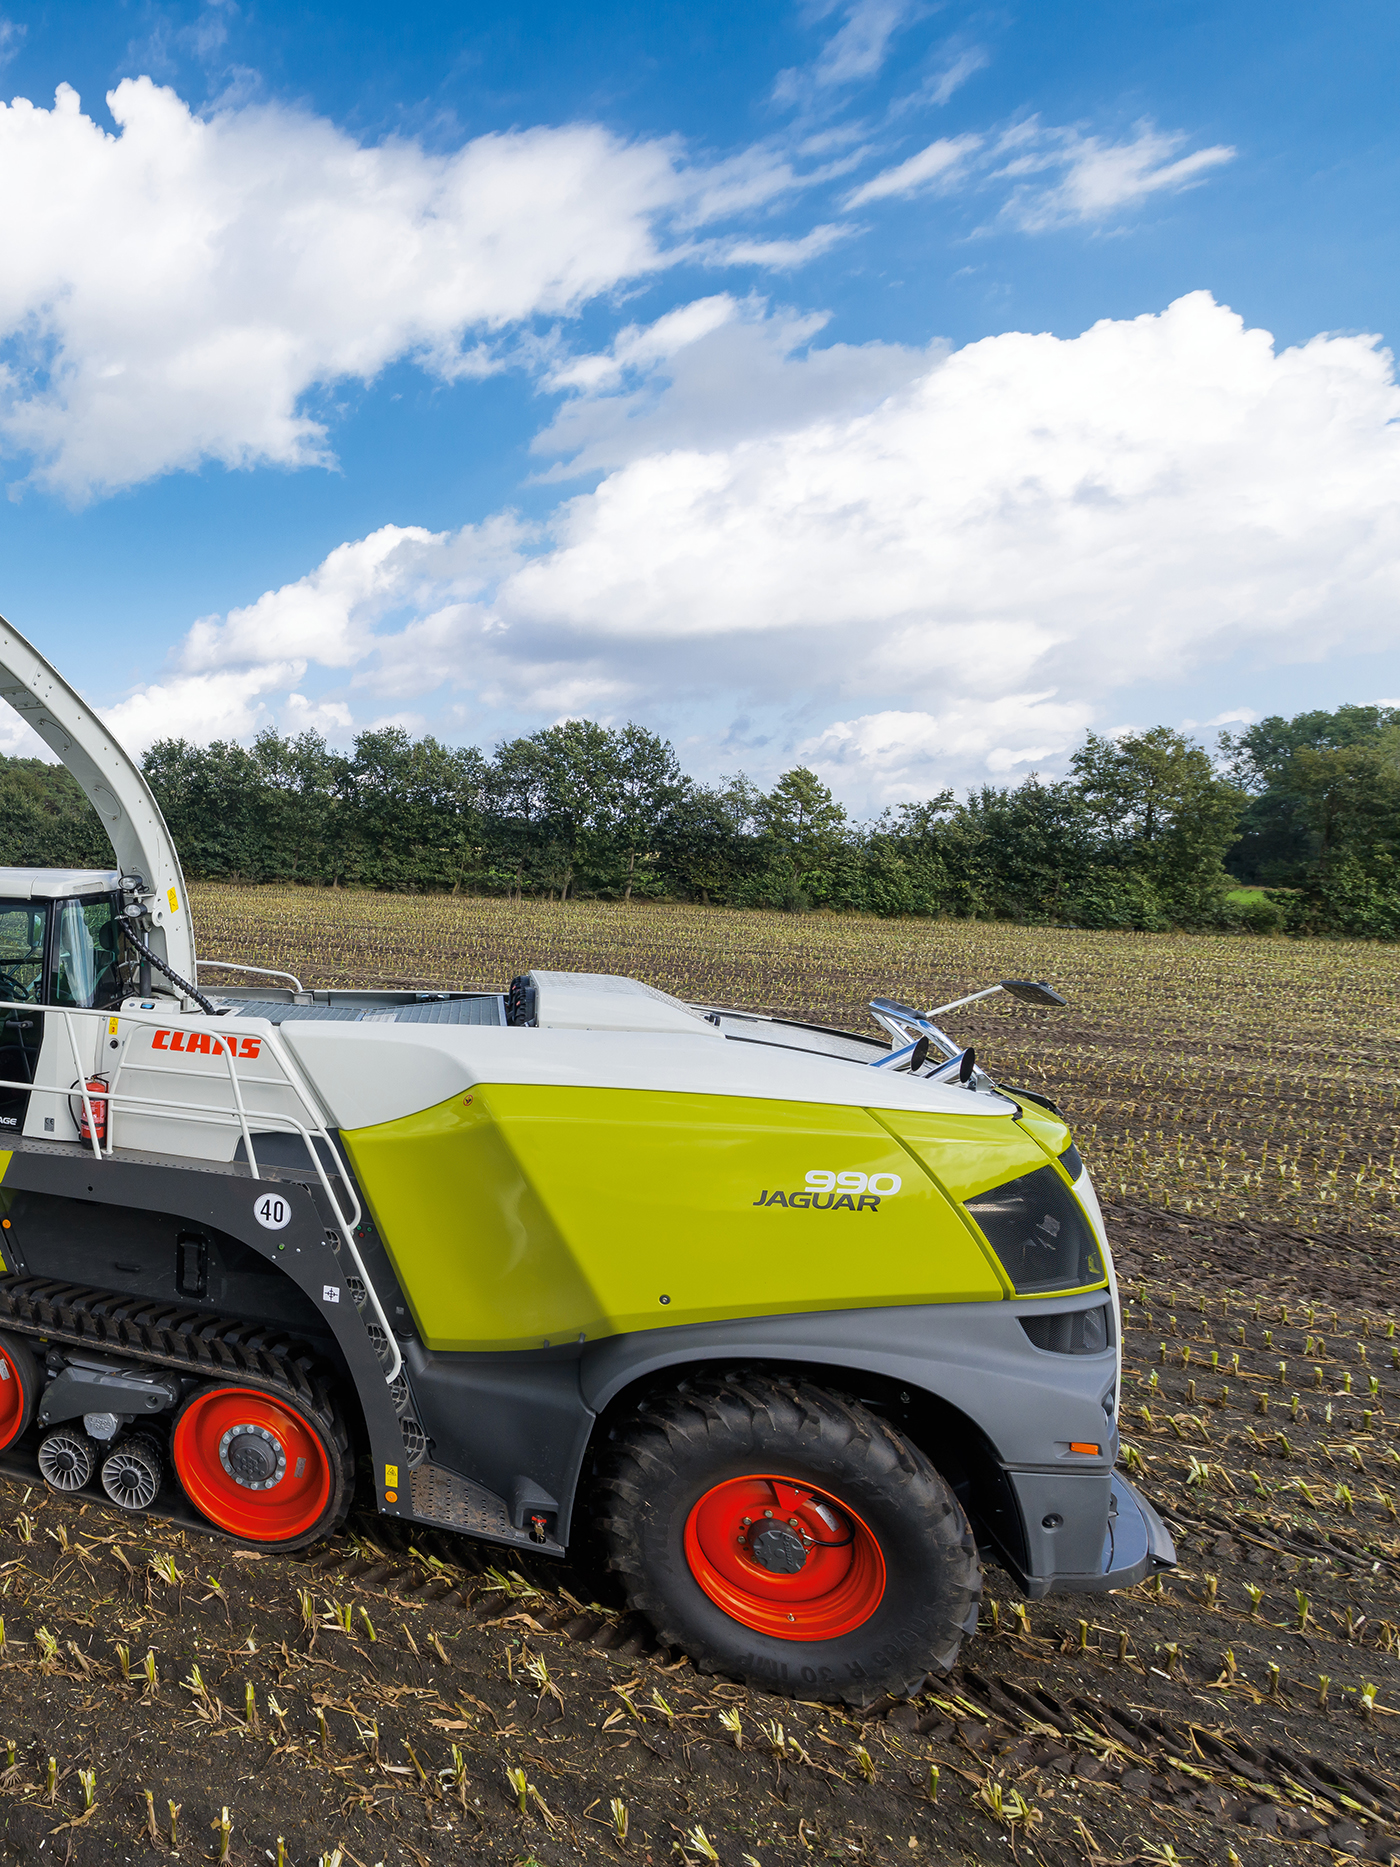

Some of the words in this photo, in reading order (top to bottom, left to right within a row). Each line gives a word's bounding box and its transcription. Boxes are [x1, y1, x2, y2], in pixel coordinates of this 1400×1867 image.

[151, 1030, 262, 1059] CLAAS
[804, 1170, 902, 1196] 990
[260, 1199, 284, 1223] 40
[752, 1190, 881, 1212] JAGUAR
